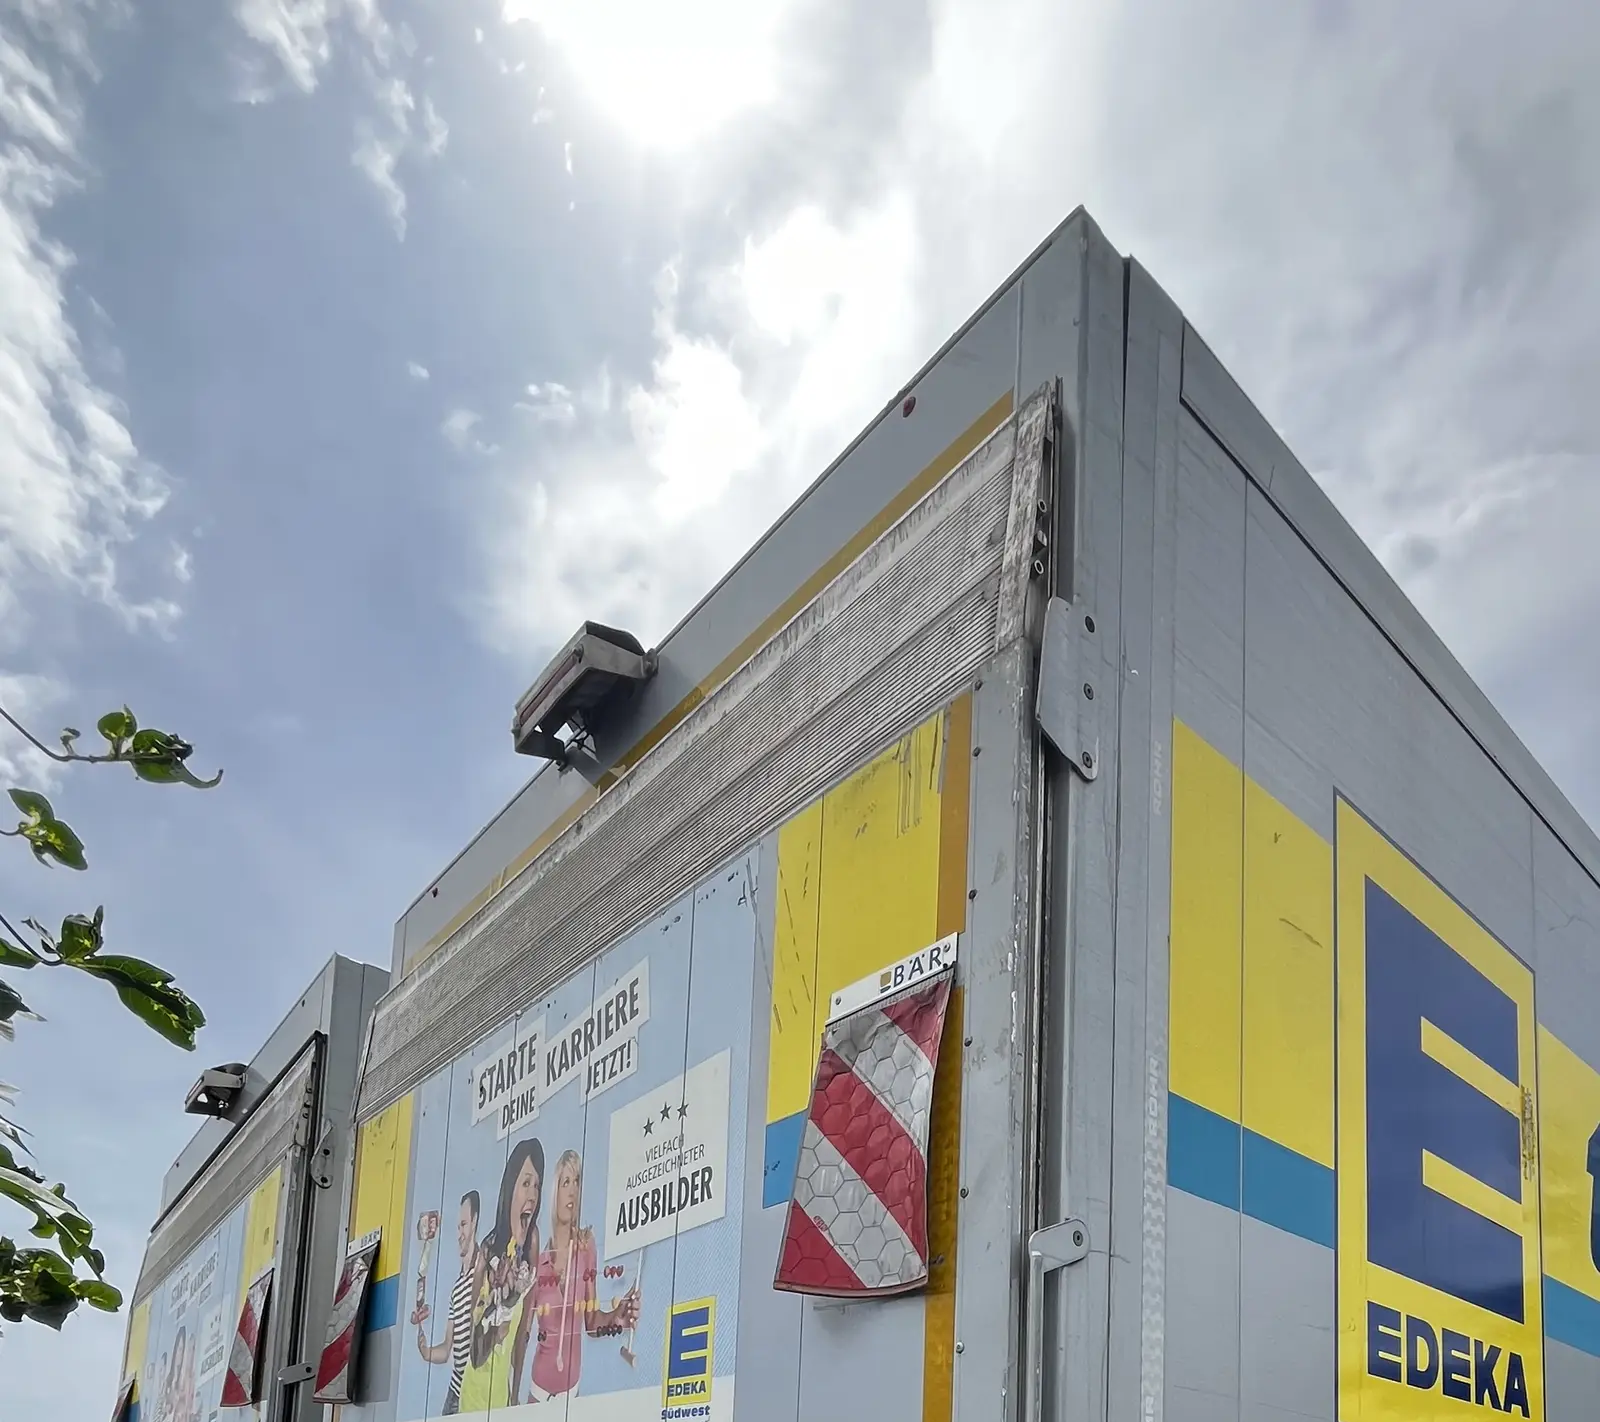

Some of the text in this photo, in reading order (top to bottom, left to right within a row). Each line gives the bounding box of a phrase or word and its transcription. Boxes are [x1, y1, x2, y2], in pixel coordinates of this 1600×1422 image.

[894, 946, 942, 988] BÄR
[478, 977, 639, 1109] STARTE KARRIERE
[502, 1040, 632, 1129] DEINE JETZT!
[626, 1144, 705, 1191] AUSGEZEICHNETER
[645, 1133, 685, 1163] VIELFACH
[616, 1166, 713, 1236] AUSBILDER
[1367, 1300, 1530, 1419] EDEKA
[667, 1380, 707, 1397] EDEKA
[661, 1405, 711, 1420] Südwest
